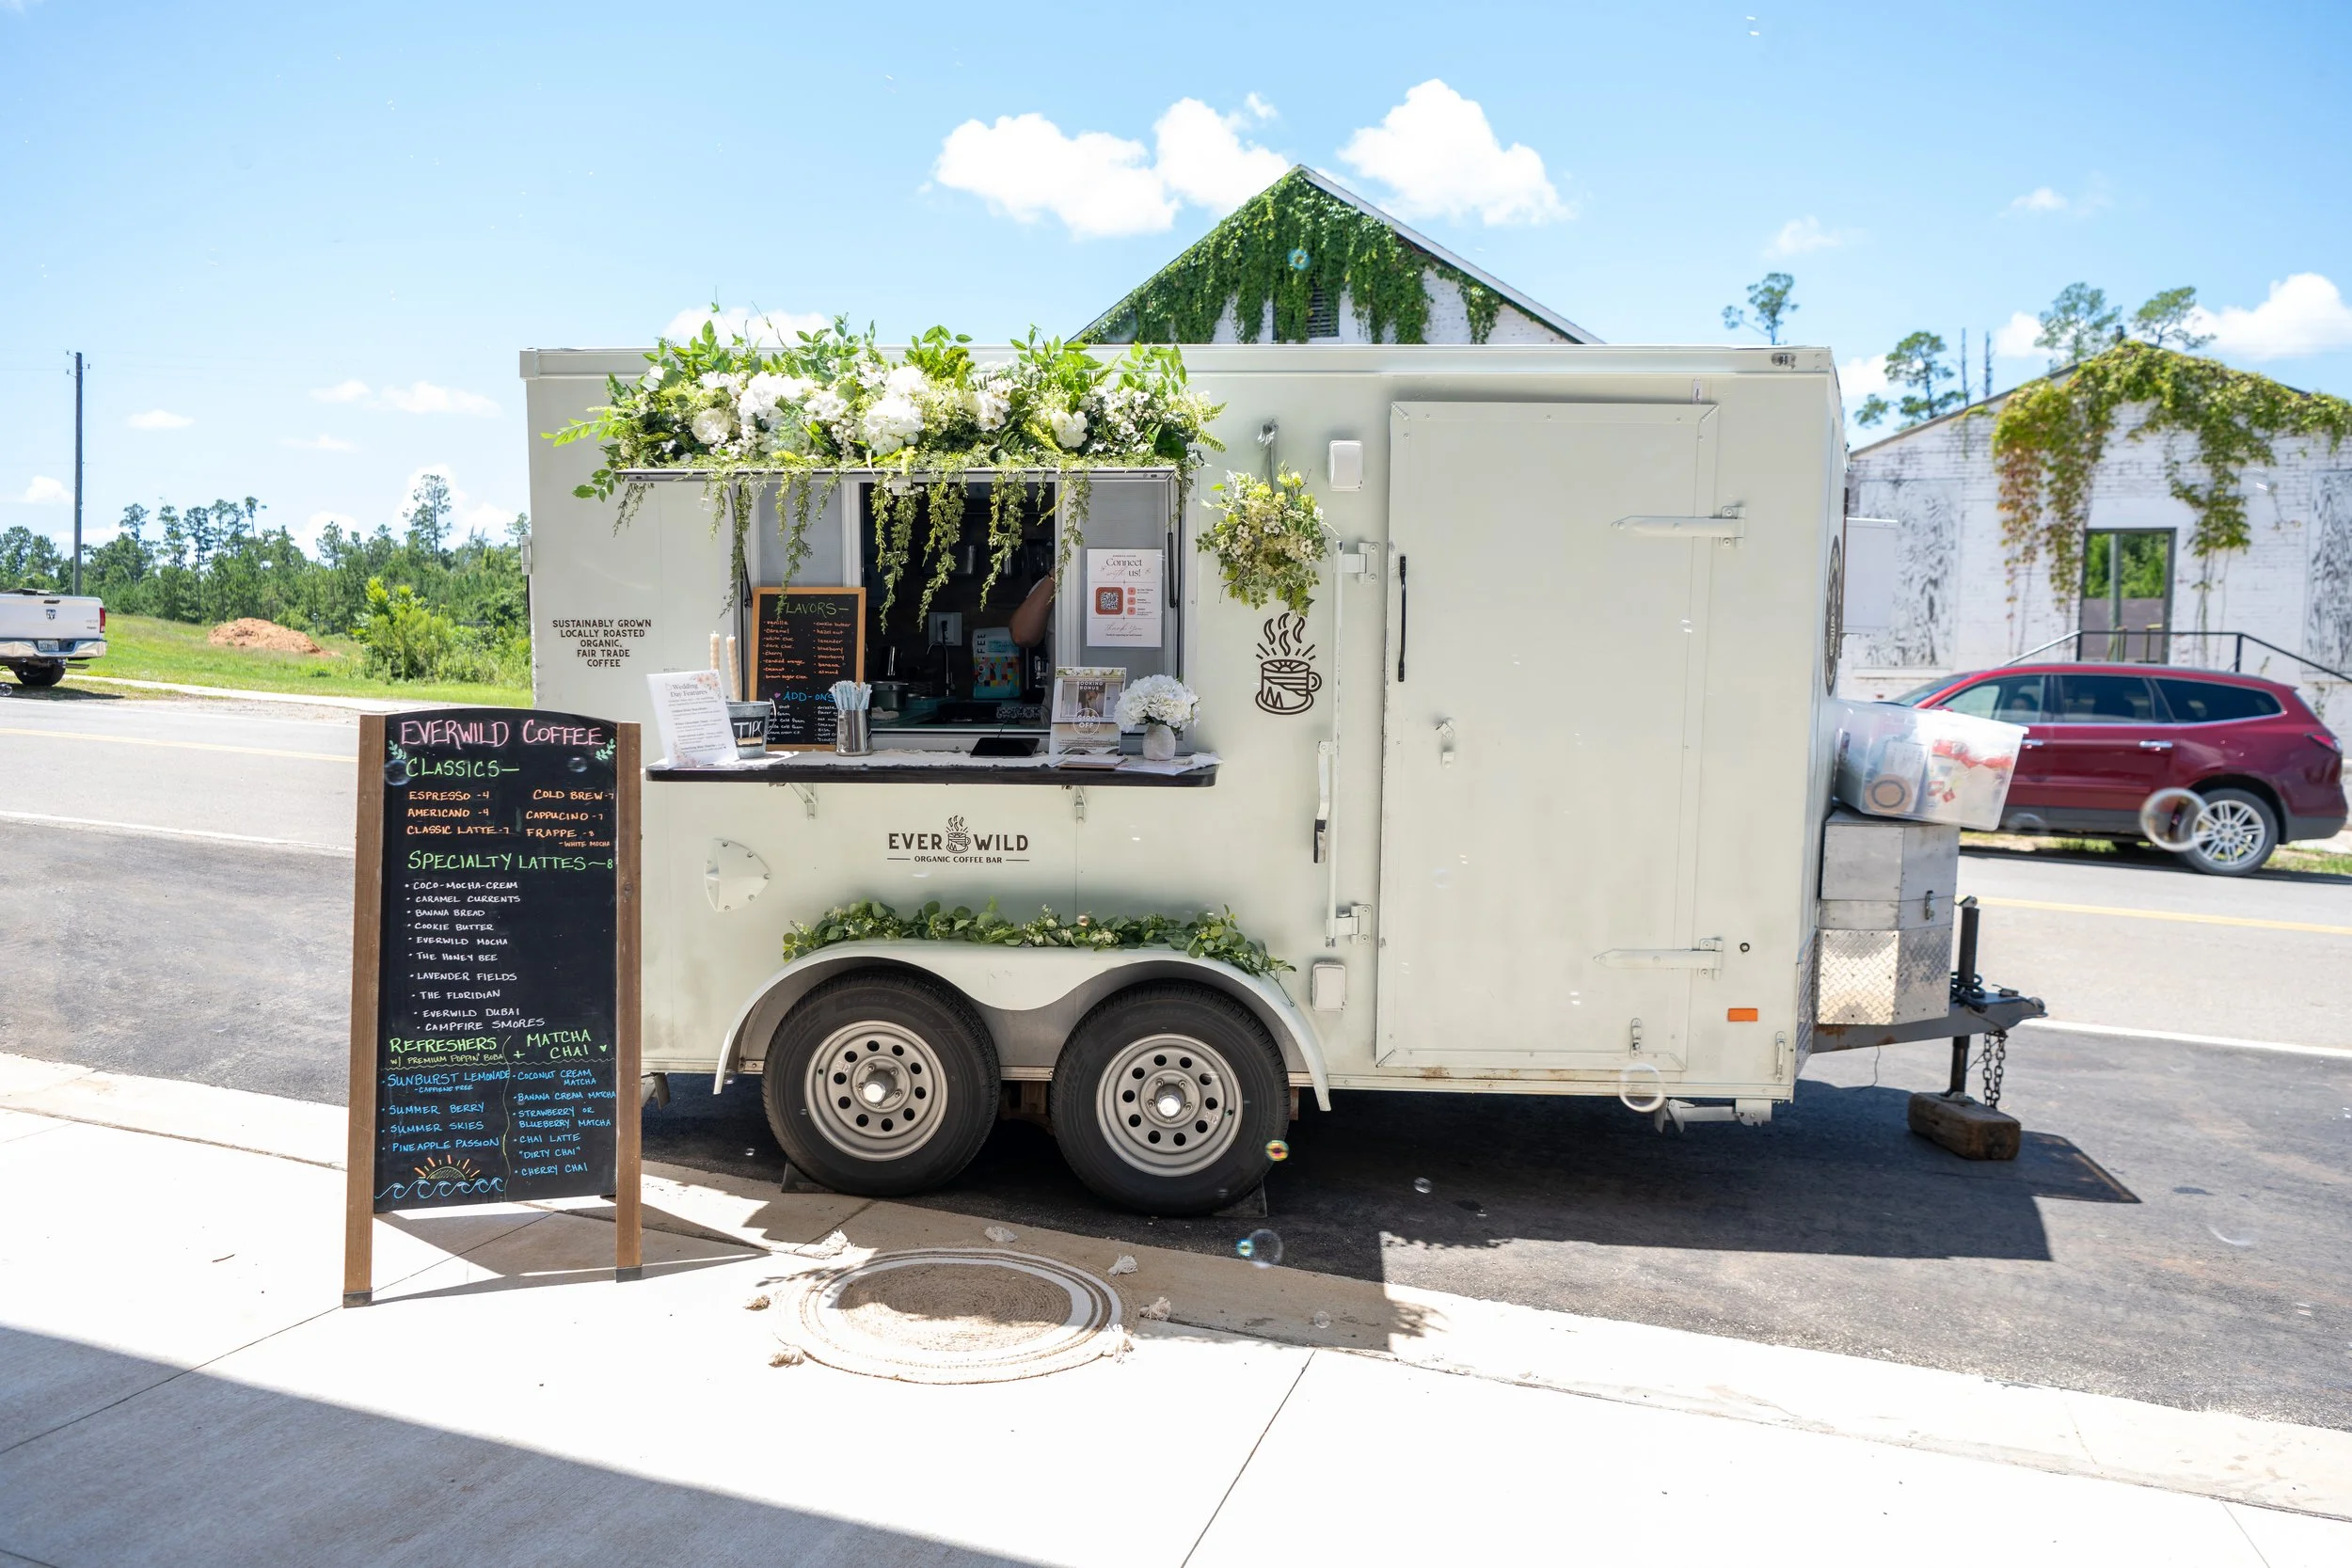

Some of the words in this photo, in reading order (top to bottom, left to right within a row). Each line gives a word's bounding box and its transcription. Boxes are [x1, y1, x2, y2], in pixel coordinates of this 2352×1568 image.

[1106, 558, 1142, 566] Connect
[560, 629, 599, 638] LOCALLY
[401, 719, 510, 750] EVERWILD
[523, 719, 606, 745] COFFEE
[409, 790, 471, 800] ESPRESSO
[533, 789, 565, 800] COLD
[407, 808, 470, 818] AMERICANO
[526, 810, 589, 821] CAPPUCINO
[407, 825, 452, 835] CLASSIC
[526, 828, 577, 838] FRAPPE
[888, 833, 942, 850] EVER
[973, 834, 1028, 851] WILD
[407, 850, 512, 871] SPECIALTY
[413, 881, 518, 890] COCO-MOCHA-CREAM
[415, 895, 461, 903] CARAMEL
[415, 909, 449, 917] BANANA
[453, 909, 485, 917] BREAD
[415, 922, 449, 931] COOKIE
[455, 922, 494, 931] BUTTER
[416, 936, 469, 946] EVERWILD
[476, 937, 508, 946] MOCHA
[416, 952, 437, 961] THE
[442, 953, 474, 962] HONEY
[478, 953, 498, 962] BEE
[417, 971, 470, 981] LAVENDER
[476, 972, 517, 982] FIELDS
[420, 990, 441, 1000] THE
[447, 989, 501, 1000] FLORIDIAN
[423, 1008, 477, 1018] EVERWILD
[485, 1007, 520, 1017] DUBAI
[425, 1021, 484, 1032] CAMPFIRE
[492, 1017, 546, 1029] SMORES
[526, 1029, 592, 1048] MATCHA
[389, 1036, 497, 1054] REFRESHERS
[550, 1044, 589, 1060] CHAI
[407, 1055, 447, 1065] PREMIUM
[483, 1053, 503, 1061] BOBA
[387, 1072, 459, 1087] SUNBURST
[464, 1069, 511, 1082] LEMONADE
[517, 1070, 556, 1081] COCONUT
[560, 1069, 592, 1078] CREAM
[517, 1093, 550, 1102] BANANA
[554, 1092, 584, 1100] CREAM
[588, 1090, 617, 1099] MATCHA
[389, 1104, 441, 1115] SUMMER
[449, 1102, 485, 1114] BERRY
[518, 1107, 575, 1118] STRAWBERRY
[583, 1106, 595, 1114] OR
[390, 1123, 443, 1134] SUMMER
[449, 1121, 484, 1130] SKIES
[519, 1119, 570, 1129] BLUEBERRY
[519, 1135, 544, 1144] CHAI
[550, 1133, 581, 1143] LATTE
[392, 1140, 451, 1153] PINEAPPLE
[455, 1137, 499, 1149] PASSION
[522, 1166, 558, 1176] CHERRY
[564, 1162, 588, 1173] CHAI
